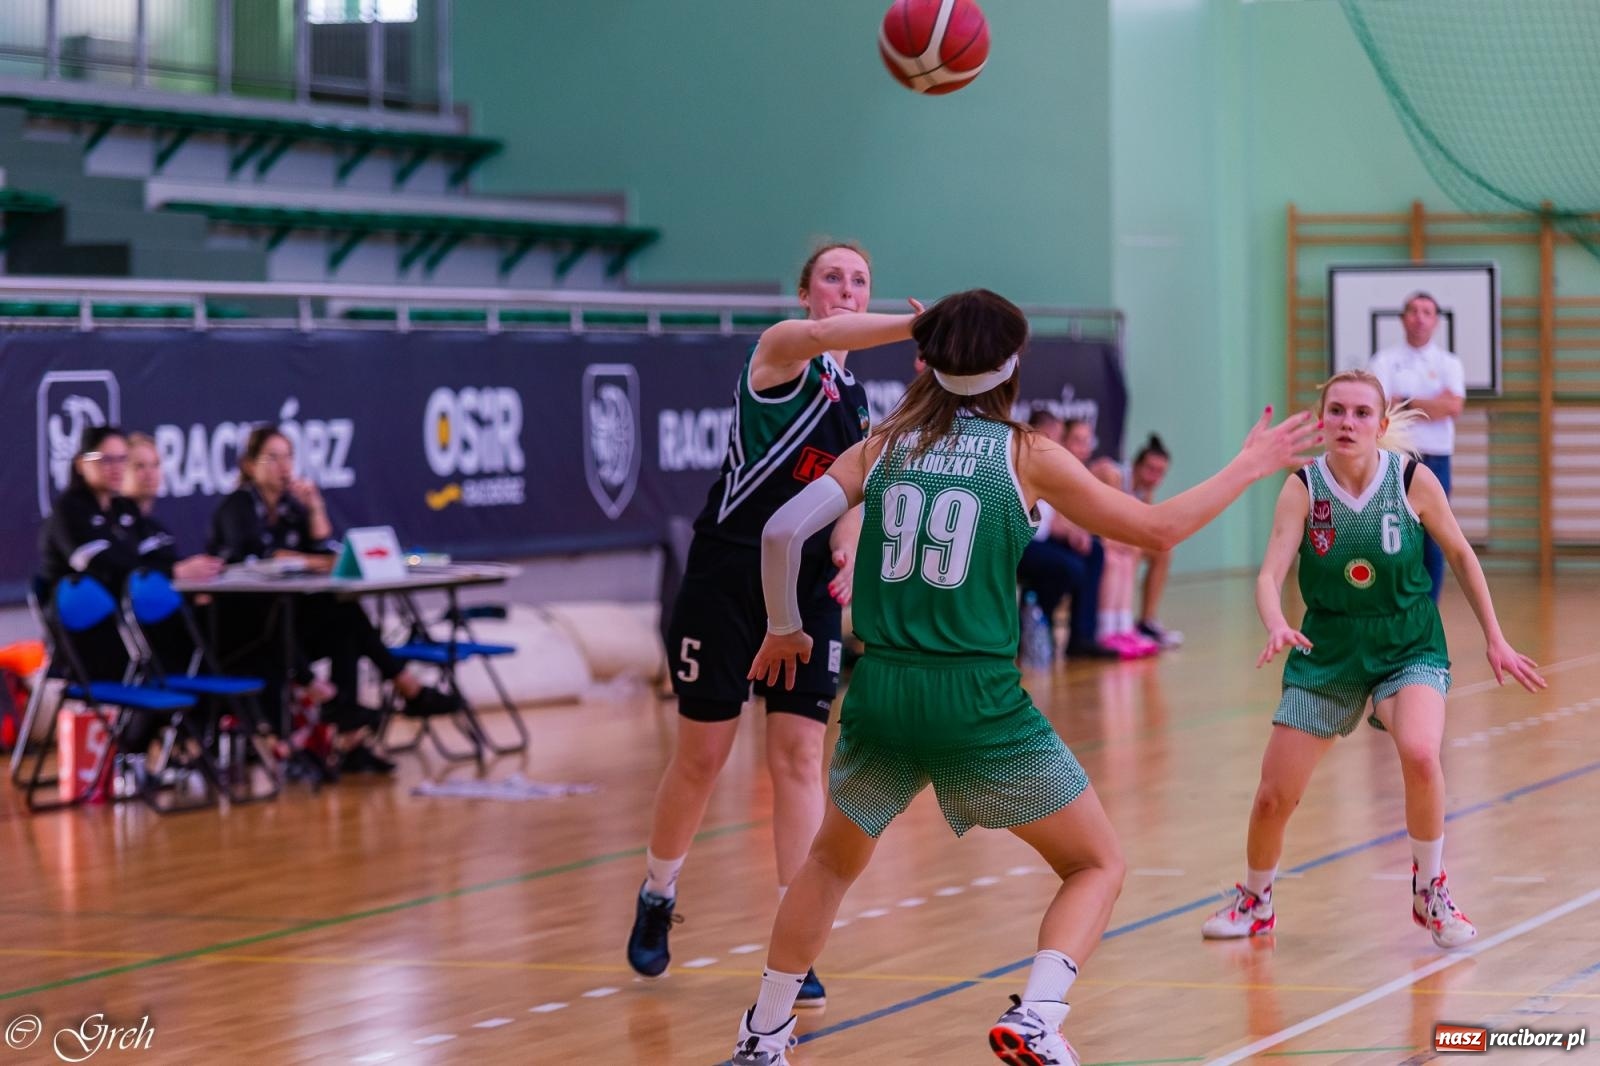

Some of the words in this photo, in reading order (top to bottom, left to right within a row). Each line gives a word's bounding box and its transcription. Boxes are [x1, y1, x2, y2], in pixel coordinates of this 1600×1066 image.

[154, 397, 355, 498] RACÓRZ
[880, 480, 981, 590] 99
[1381, 512, 1402, 555] 6
[677, 636, 702, 683] 5
